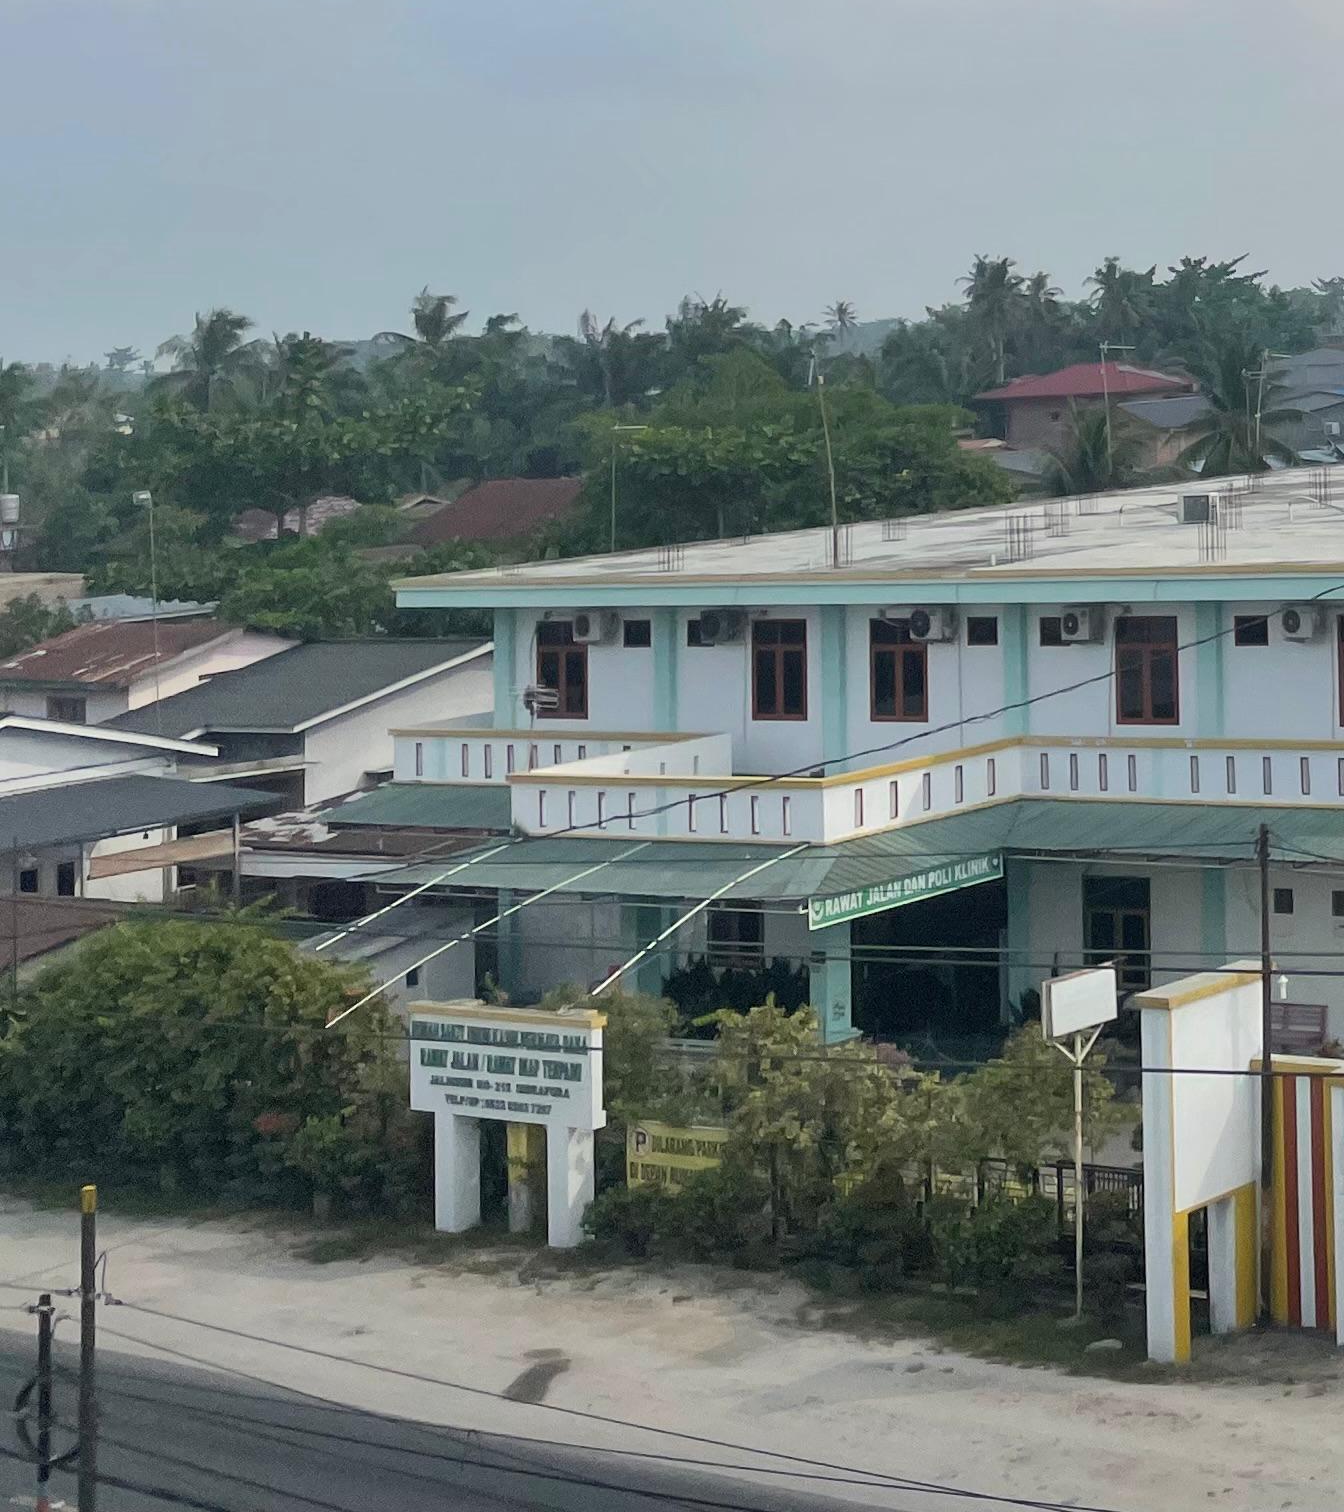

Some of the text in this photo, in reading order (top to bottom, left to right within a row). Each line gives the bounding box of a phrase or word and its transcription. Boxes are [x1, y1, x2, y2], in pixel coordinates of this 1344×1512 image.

[825, 856, 990, 917] RAWAT JALAN DAN POLI KLINIK
